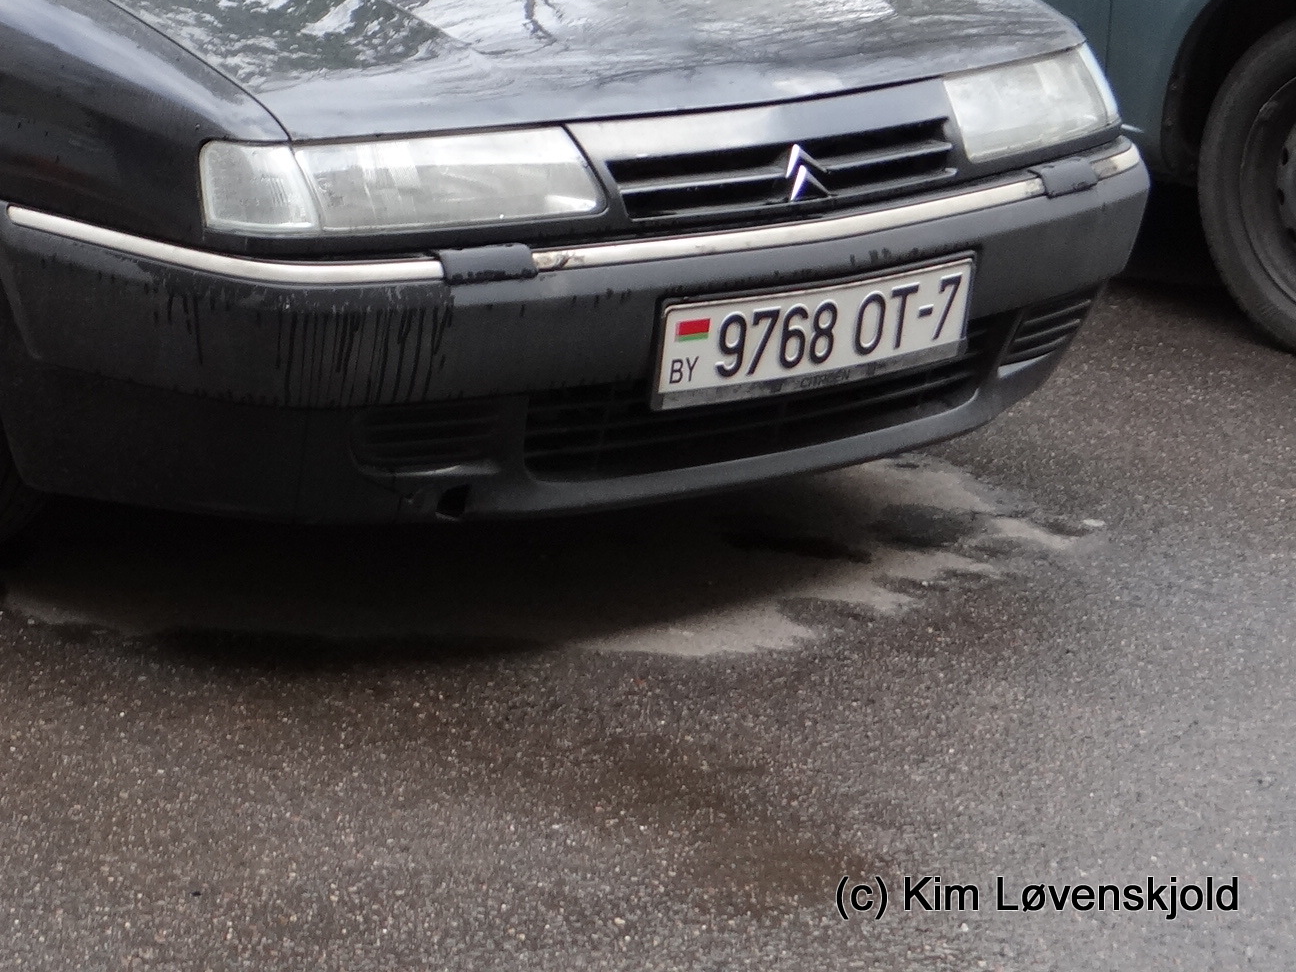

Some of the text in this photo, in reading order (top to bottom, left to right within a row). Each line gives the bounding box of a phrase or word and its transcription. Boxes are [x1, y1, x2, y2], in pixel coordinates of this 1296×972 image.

[715, 273, 964, 378] 9768 OT-7
[669, 356, 699, 384] BY
